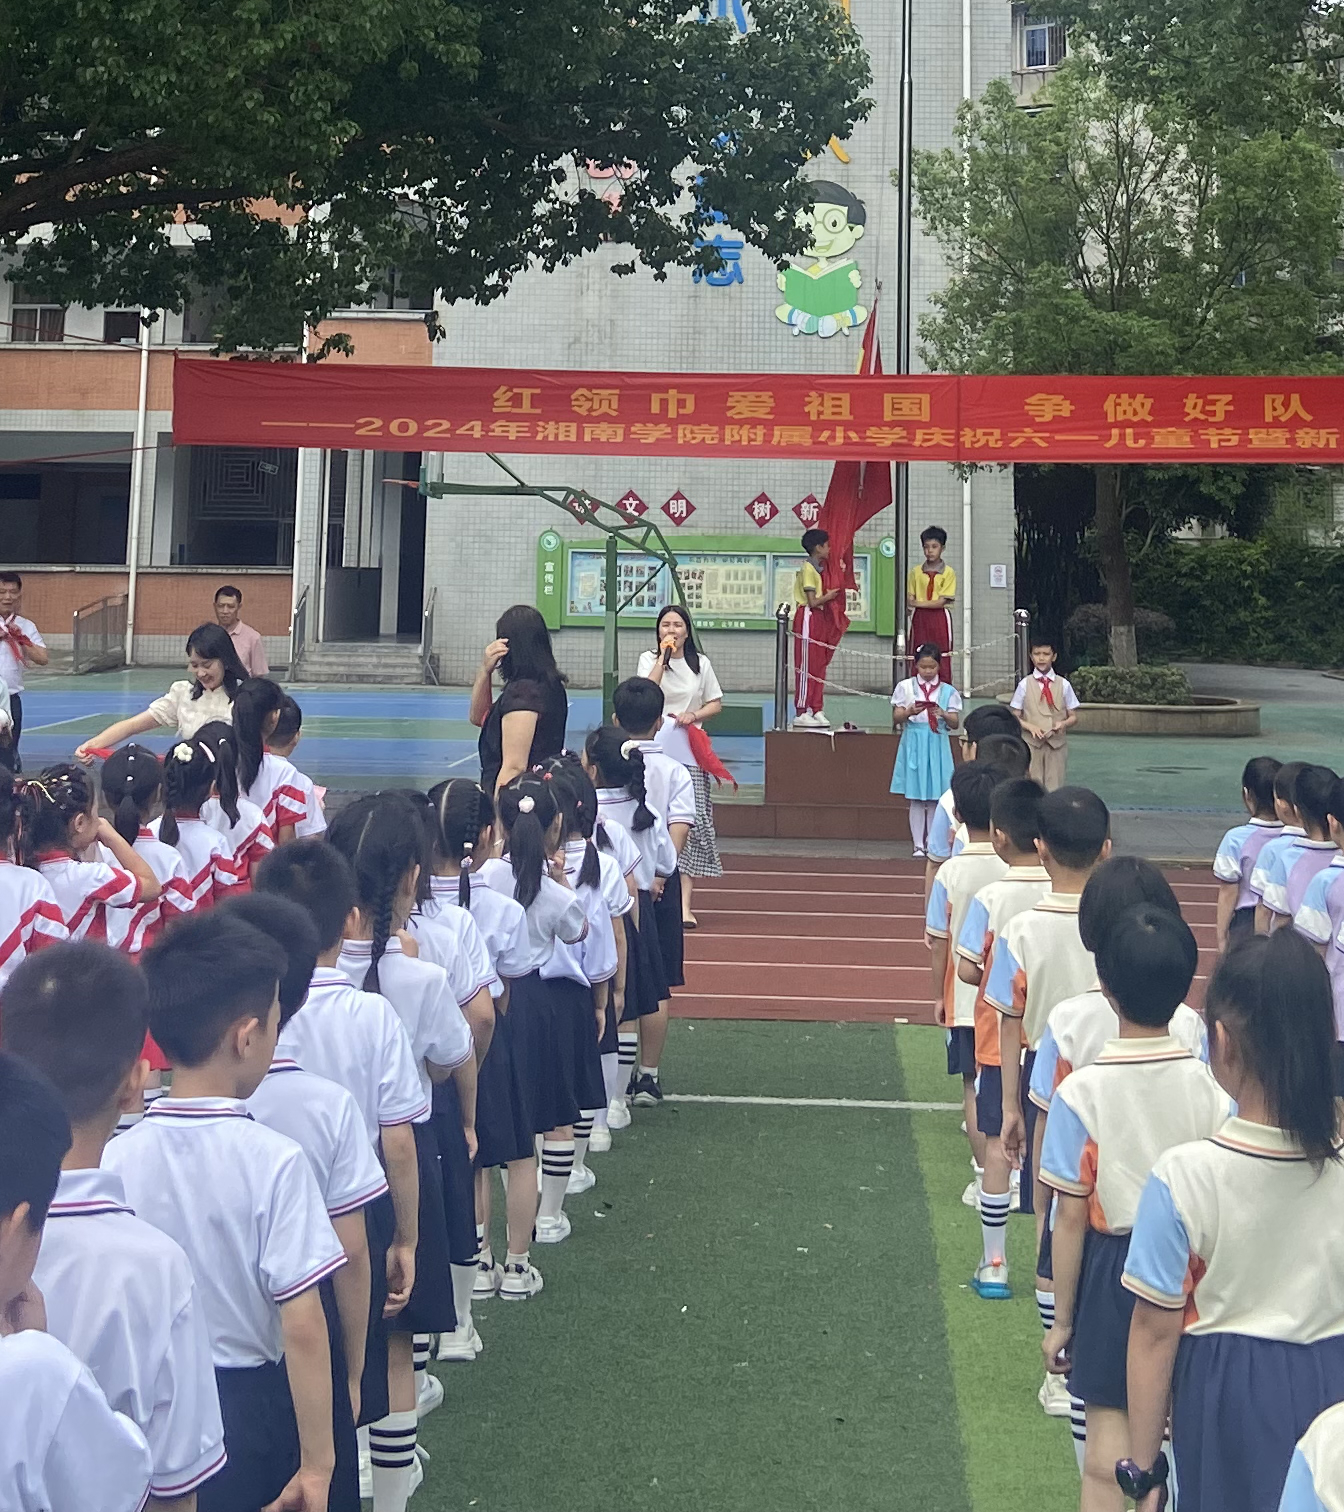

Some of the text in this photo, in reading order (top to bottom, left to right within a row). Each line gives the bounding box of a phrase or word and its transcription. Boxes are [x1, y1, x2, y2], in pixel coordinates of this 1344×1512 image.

[492, 384, 934, 423] 红领巾爱祖国
